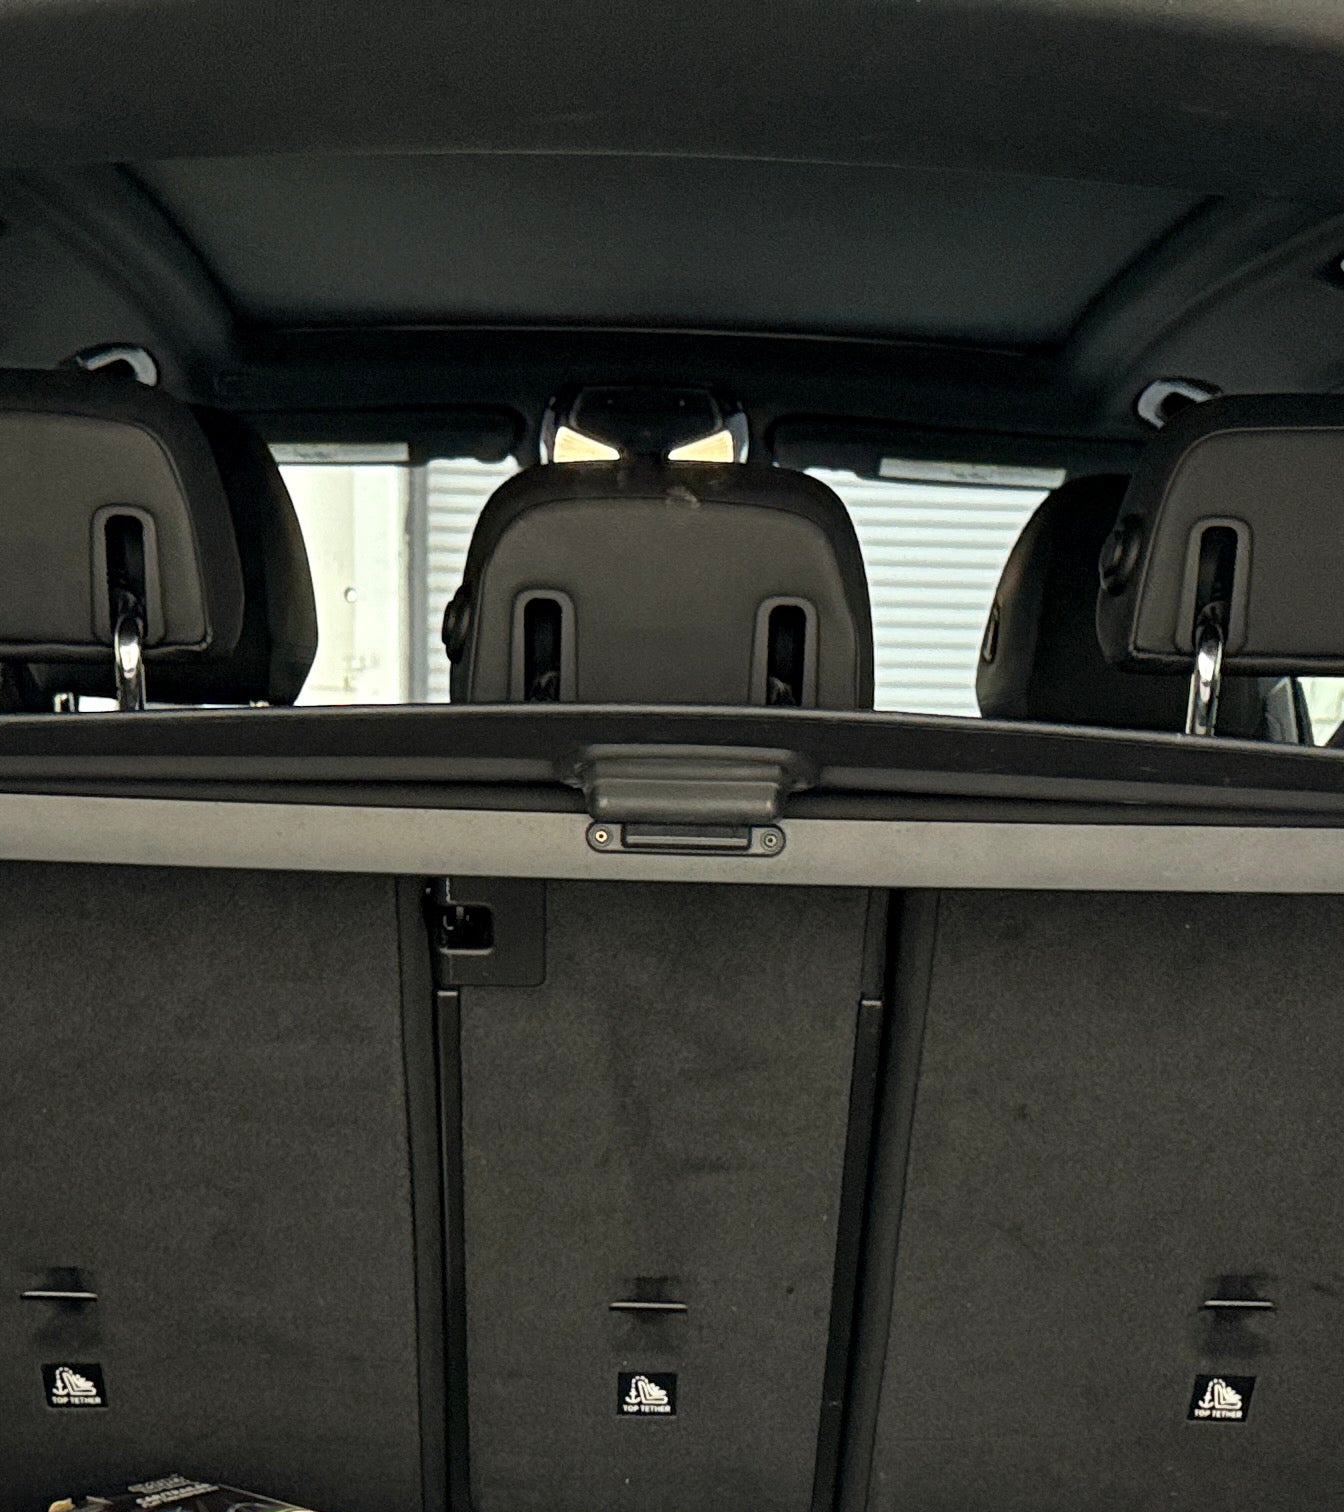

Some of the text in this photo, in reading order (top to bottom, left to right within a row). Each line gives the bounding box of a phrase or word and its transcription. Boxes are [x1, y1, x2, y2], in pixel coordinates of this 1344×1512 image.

[52, 1396, 102, 1404] TOP TETHER
[623, 1404, 671, 1413] TOP TETHER
[1194, 1409, 1243, 1418] TOP TETHER
